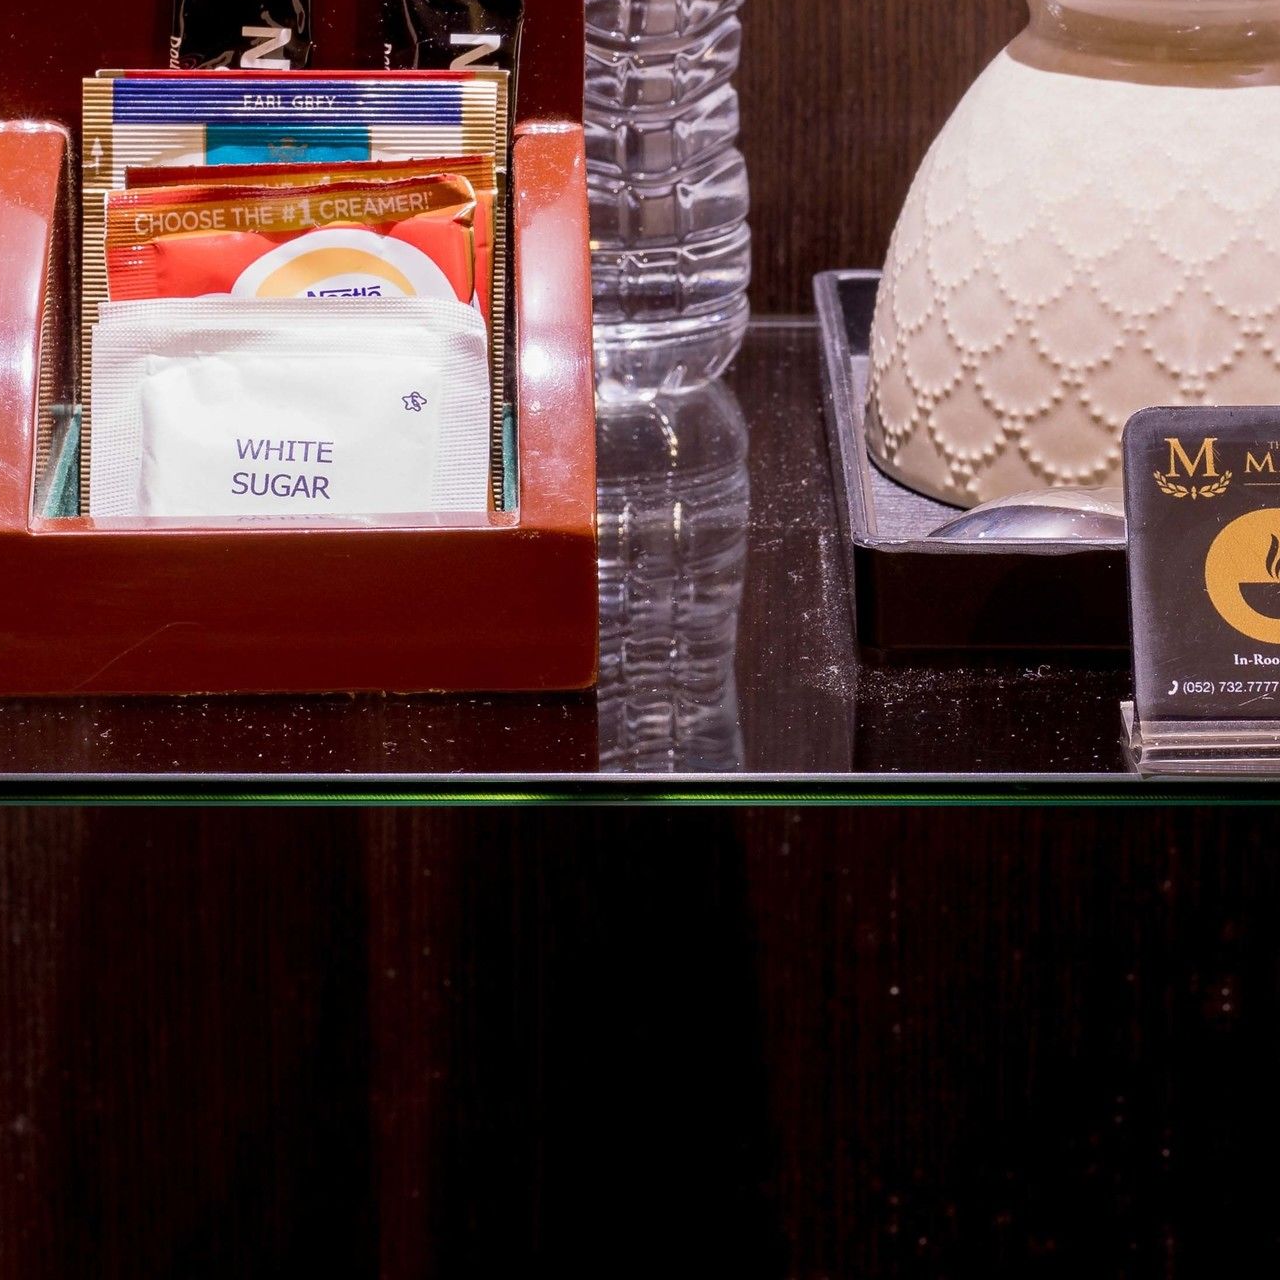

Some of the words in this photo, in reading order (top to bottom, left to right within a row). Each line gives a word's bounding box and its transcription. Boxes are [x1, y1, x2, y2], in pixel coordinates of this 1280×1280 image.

[242, 94, 282, 109] EARL
[291, 94, 337, 109] GREY
[133, 207, 227, 237] CHOOSE
[230, 206, 275, 228] THE
[281, 198, 316, 226] #1
[236, 438, 334, 464] WHITE
[1163, 436, 1222, 478] M
[231, 471, 331, 500] SUGAR
[1182, 680, 1216, 695] (052)
[1218, 680, 1279, 694] 732.7777
